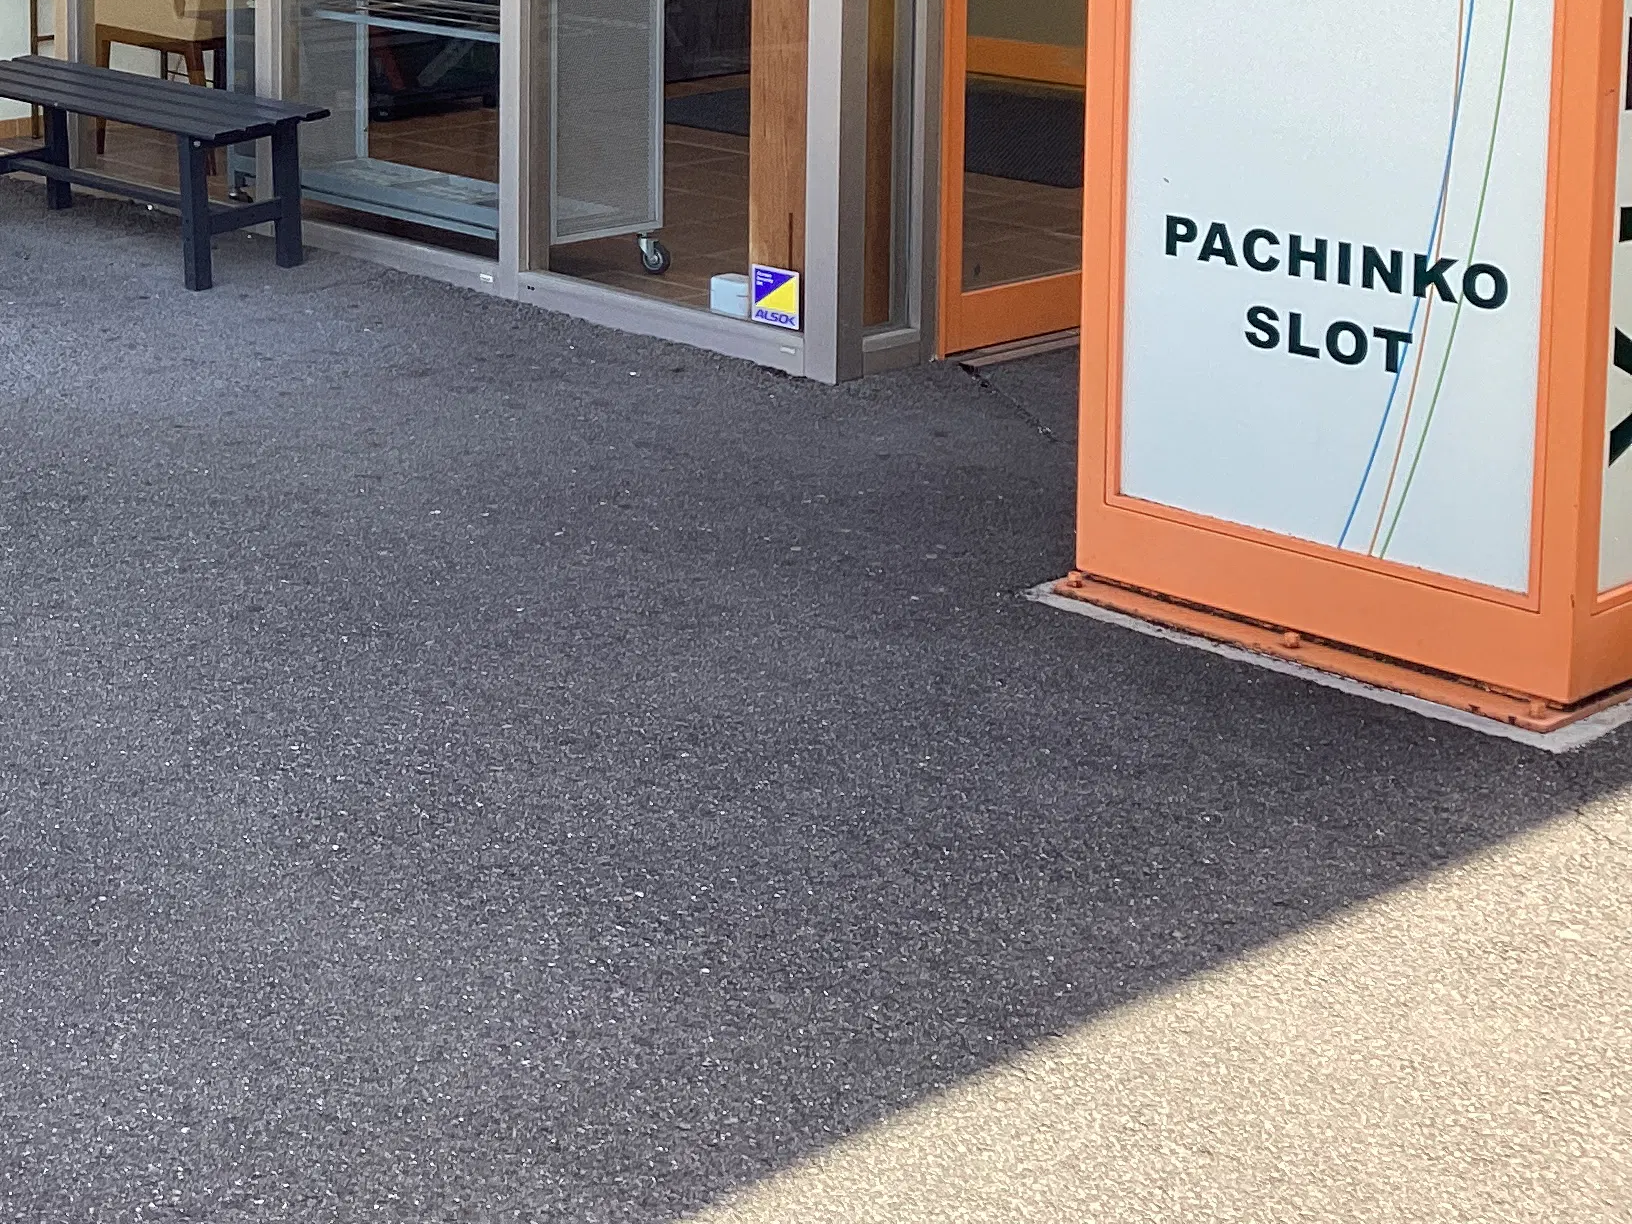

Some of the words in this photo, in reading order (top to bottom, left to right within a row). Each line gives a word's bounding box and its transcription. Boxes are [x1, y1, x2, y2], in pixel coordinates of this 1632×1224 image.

[1164, 214, 1509, 311] PACHINKO
[755, 309, 796, 326] ALSOK
[1243, 304, 1413, 374] SLOT
